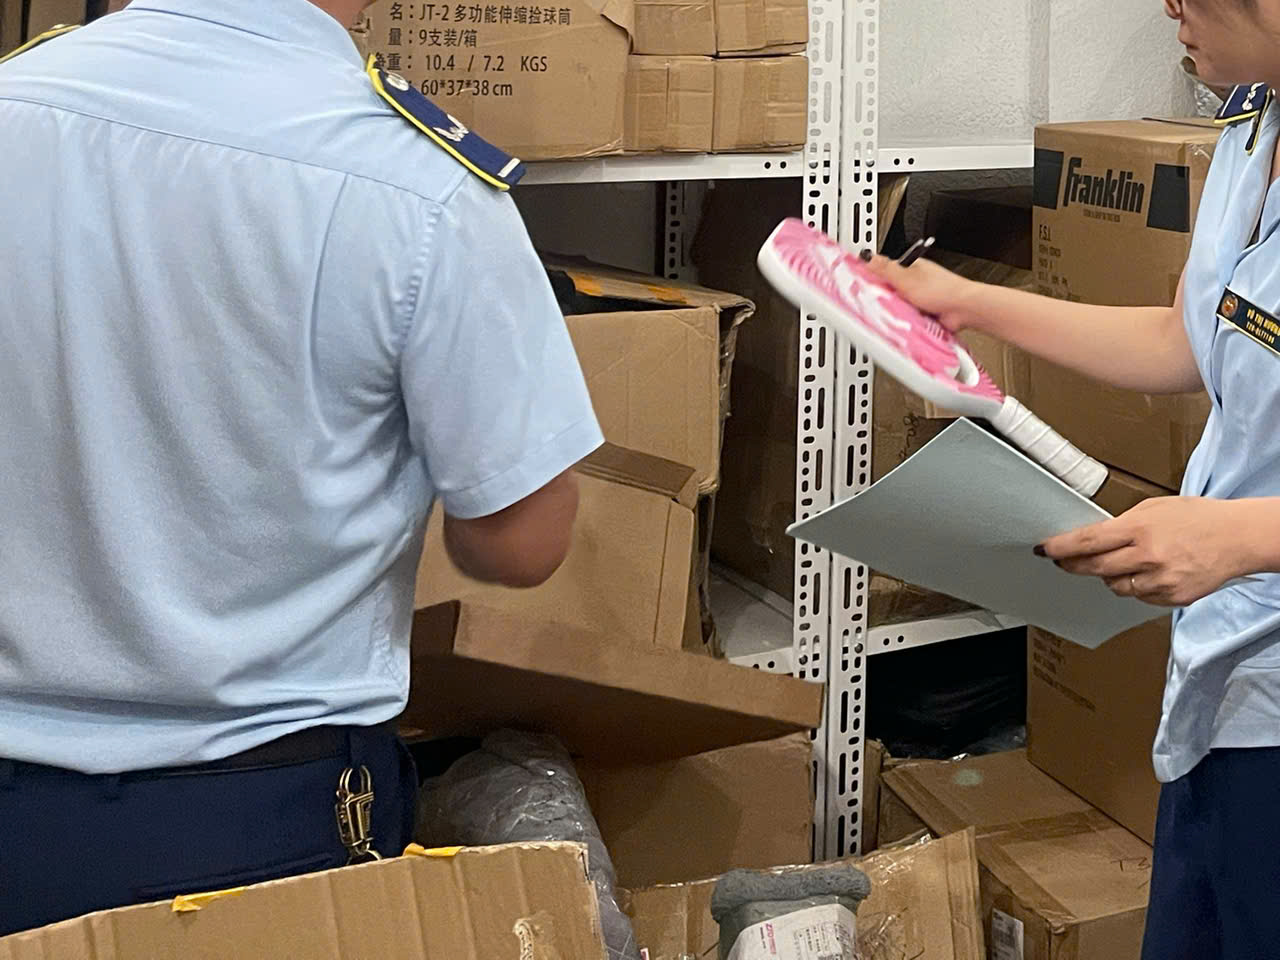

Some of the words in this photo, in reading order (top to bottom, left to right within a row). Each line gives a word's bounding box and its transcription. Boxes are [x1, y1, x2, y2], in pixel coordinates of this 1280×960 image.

[425, 55, 455, 72] 10.4
[483, 55, 505, 72] 7.2
[520, 55, 548, 72] KGS
[1063, 157, 1146, 213] franklin
